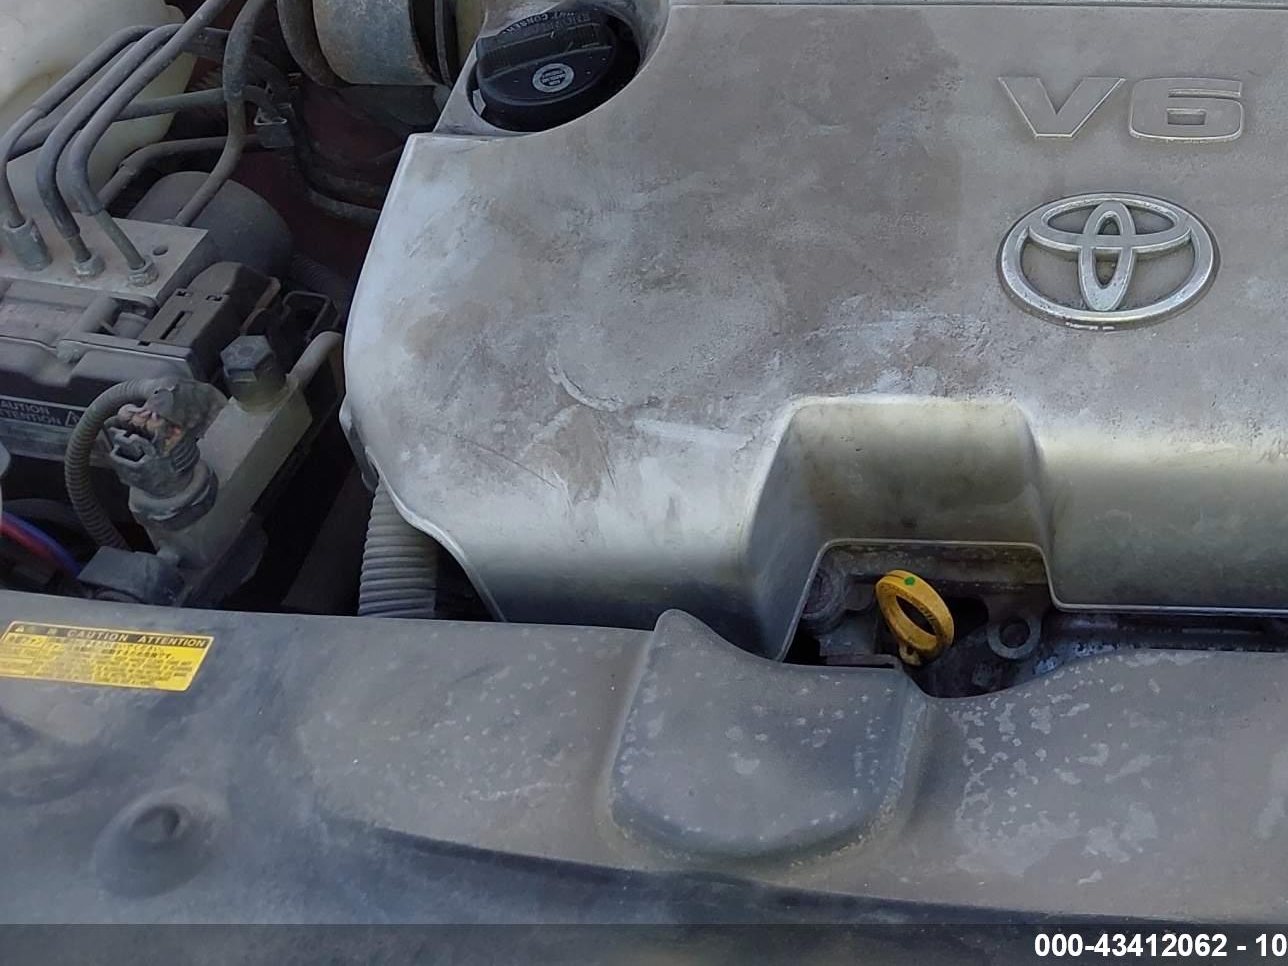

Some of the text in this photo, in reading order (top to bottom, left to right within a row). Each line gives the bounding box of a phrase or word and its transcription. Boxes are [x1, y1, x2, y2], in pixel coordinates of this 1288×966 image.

[998, 76, 1242, 140] V6
[0, 400, 50, 415] AUTION
[66, 629, 129, 642] CAUTION
[138, 635, 207, 648] ATTENTION
